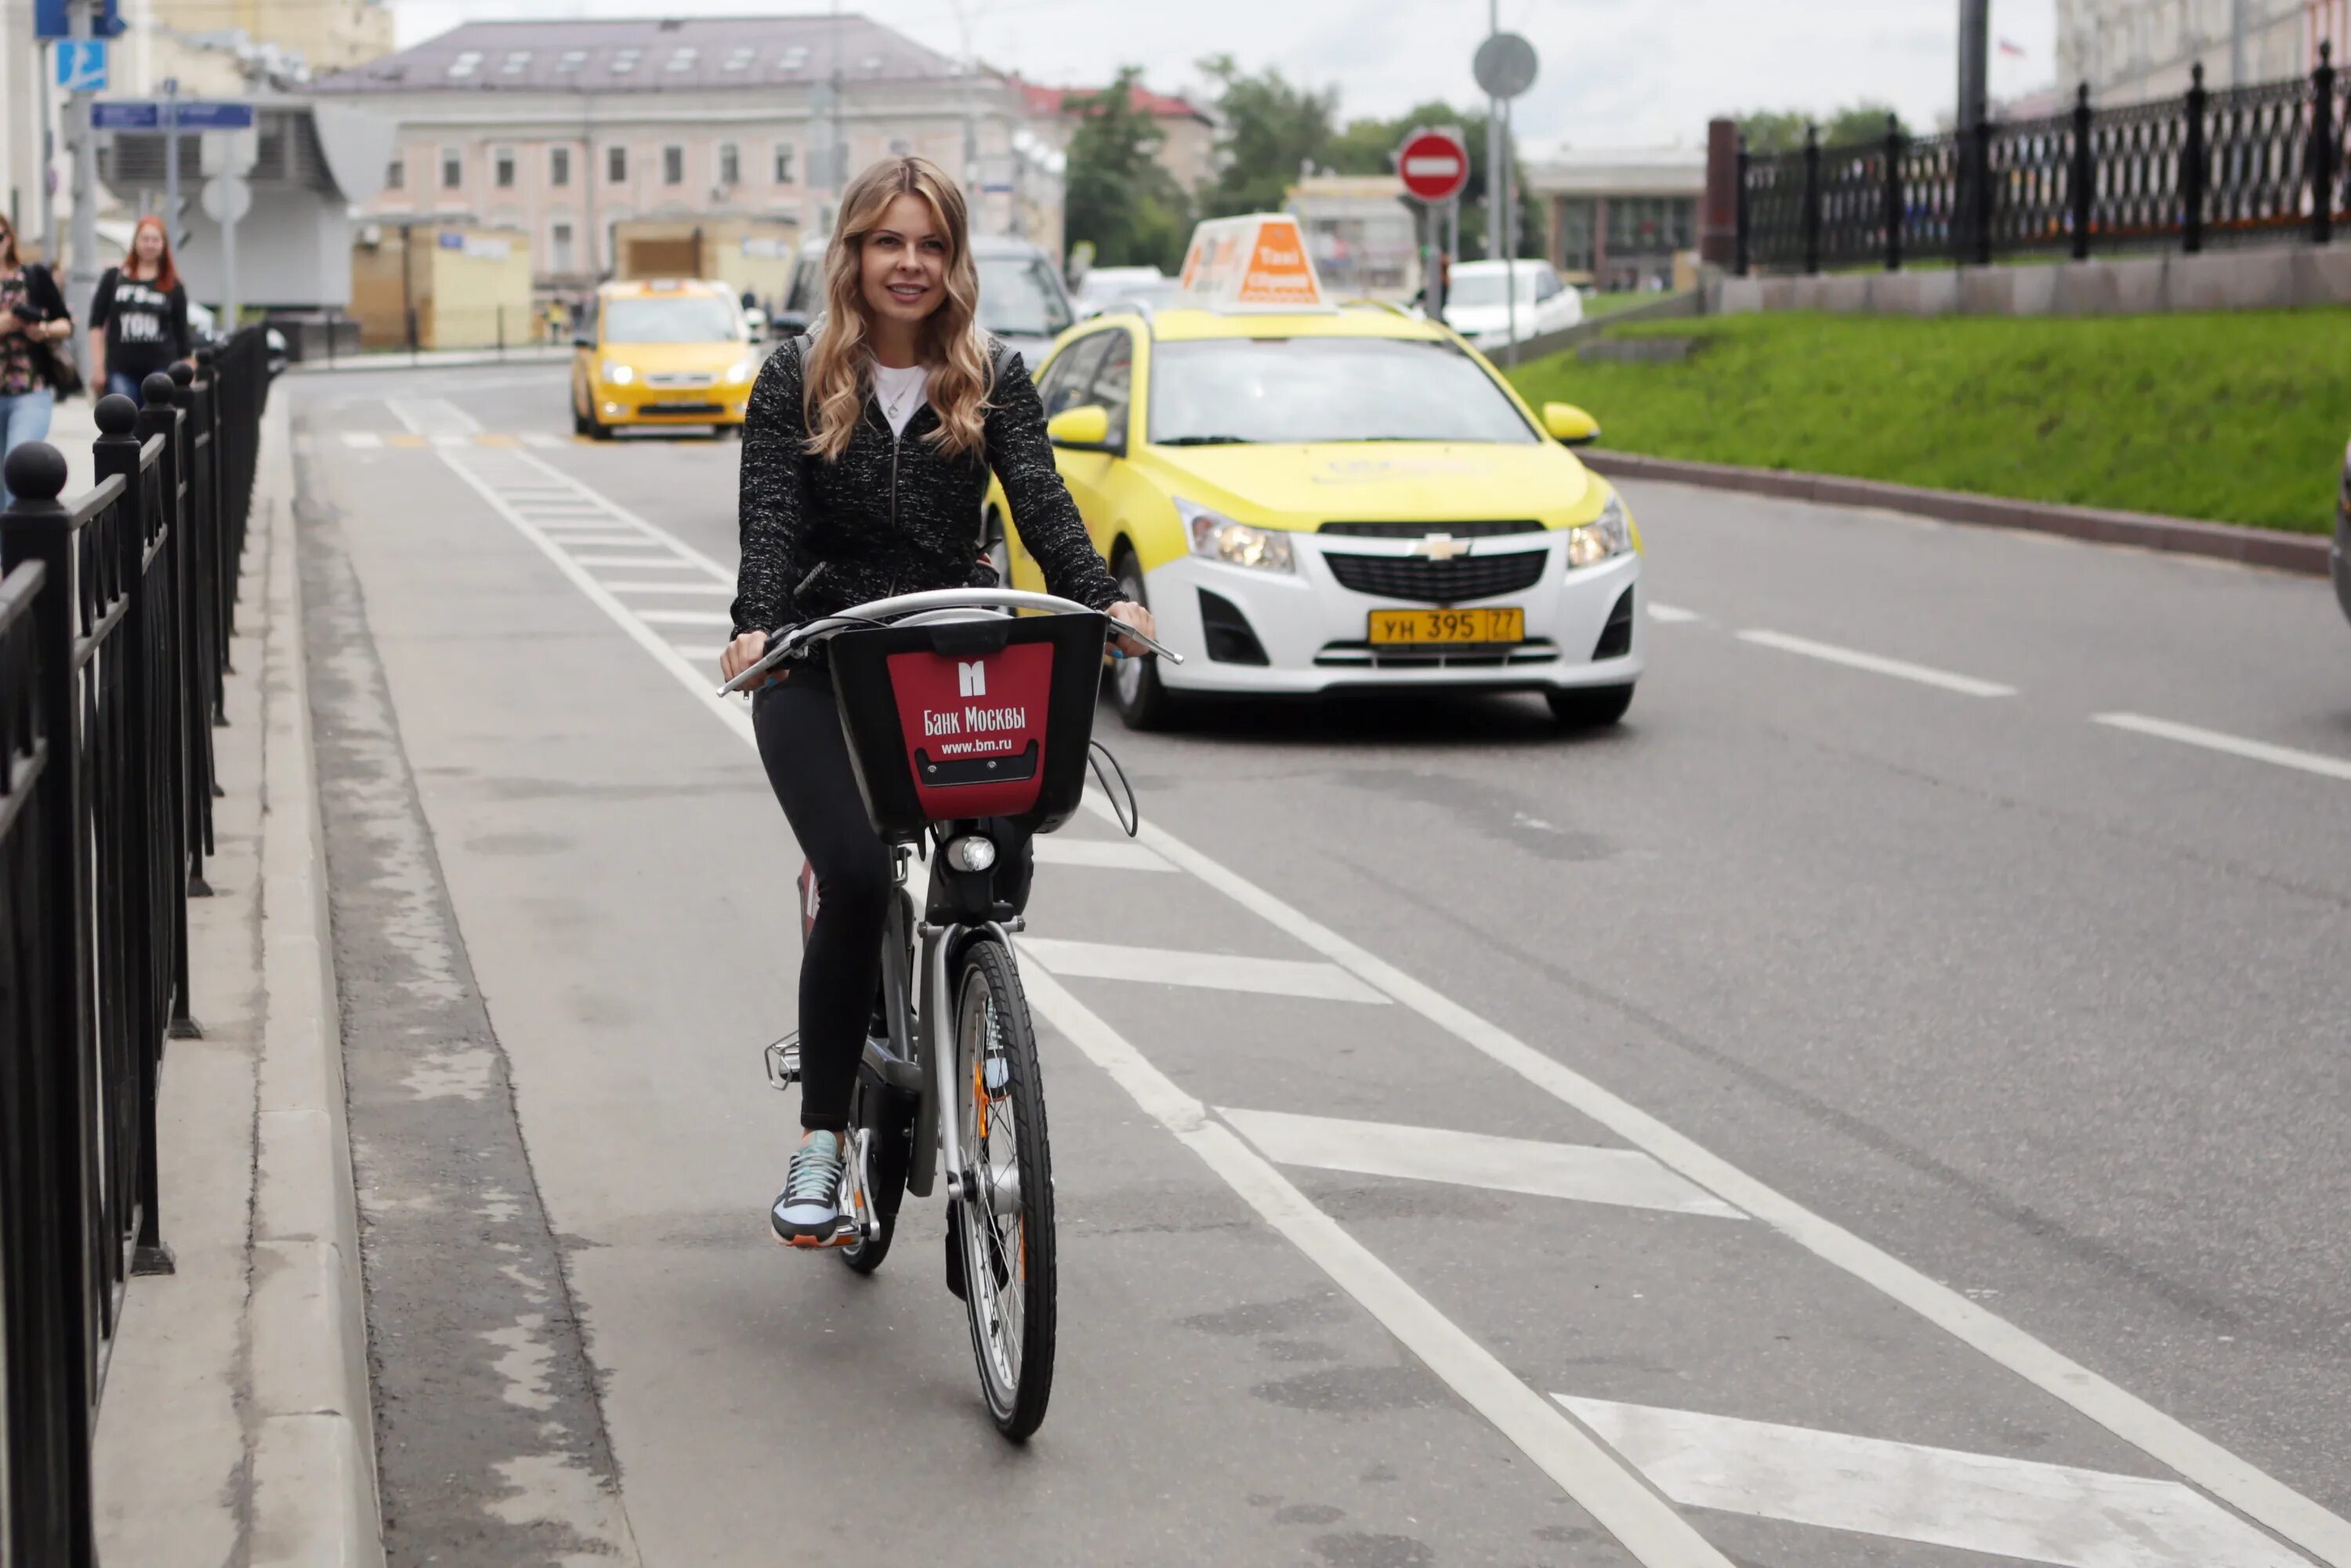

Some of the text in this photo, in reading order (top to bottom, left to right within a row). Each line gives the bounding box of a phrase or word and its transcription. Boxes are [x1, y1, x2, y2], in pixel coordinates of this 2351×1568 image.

[1259, 247, 1299, 266] Taxi
[1427, 614, 1475, 639] 395
[1491, 610, 1514, 632] 77
[923, 706, 1027, 737] Банк Москвы
[941, 738, 1013, 755] www.bm.ru
